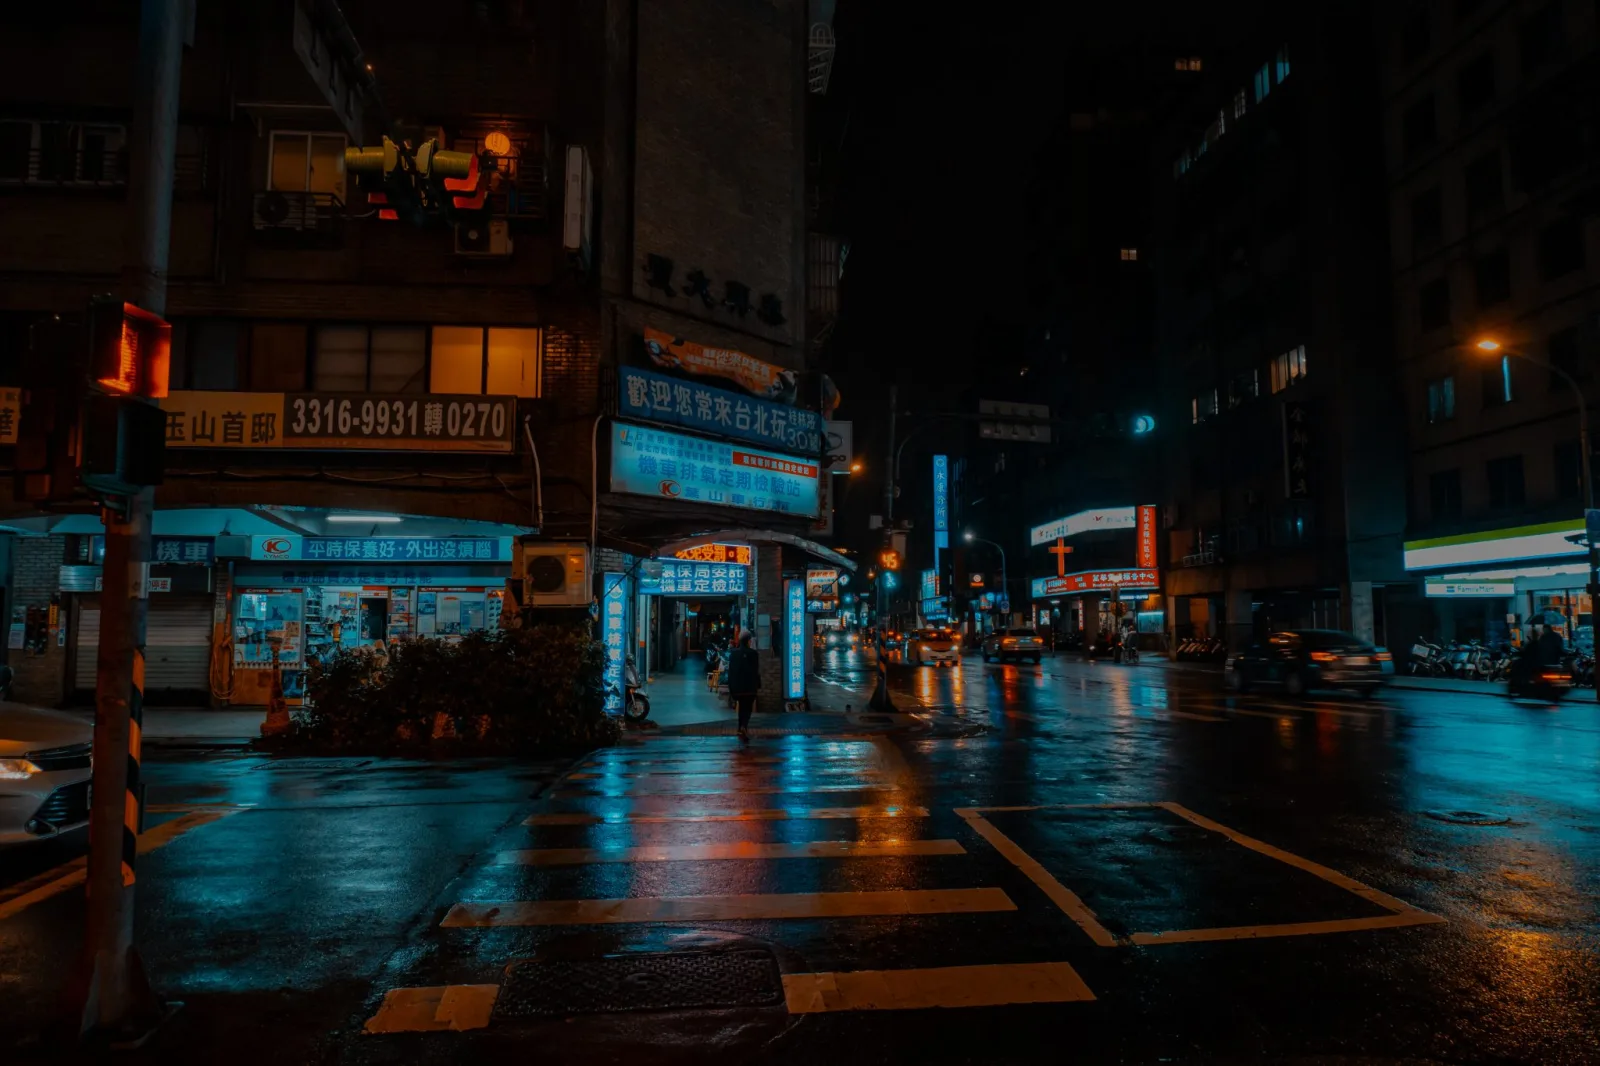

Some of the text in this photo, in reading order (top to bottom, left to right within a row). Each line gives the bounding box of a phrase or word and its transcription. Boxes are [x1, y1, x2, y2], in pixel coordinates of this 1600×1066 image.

[626, 375, 787, 443] 歡迎您常來台北玩
[637, 454, 800, 497] 機車排氣定期檢驗站
[157, 541, 208, 561] 機車
[660, 579, 744, 592] 機車定檢站
